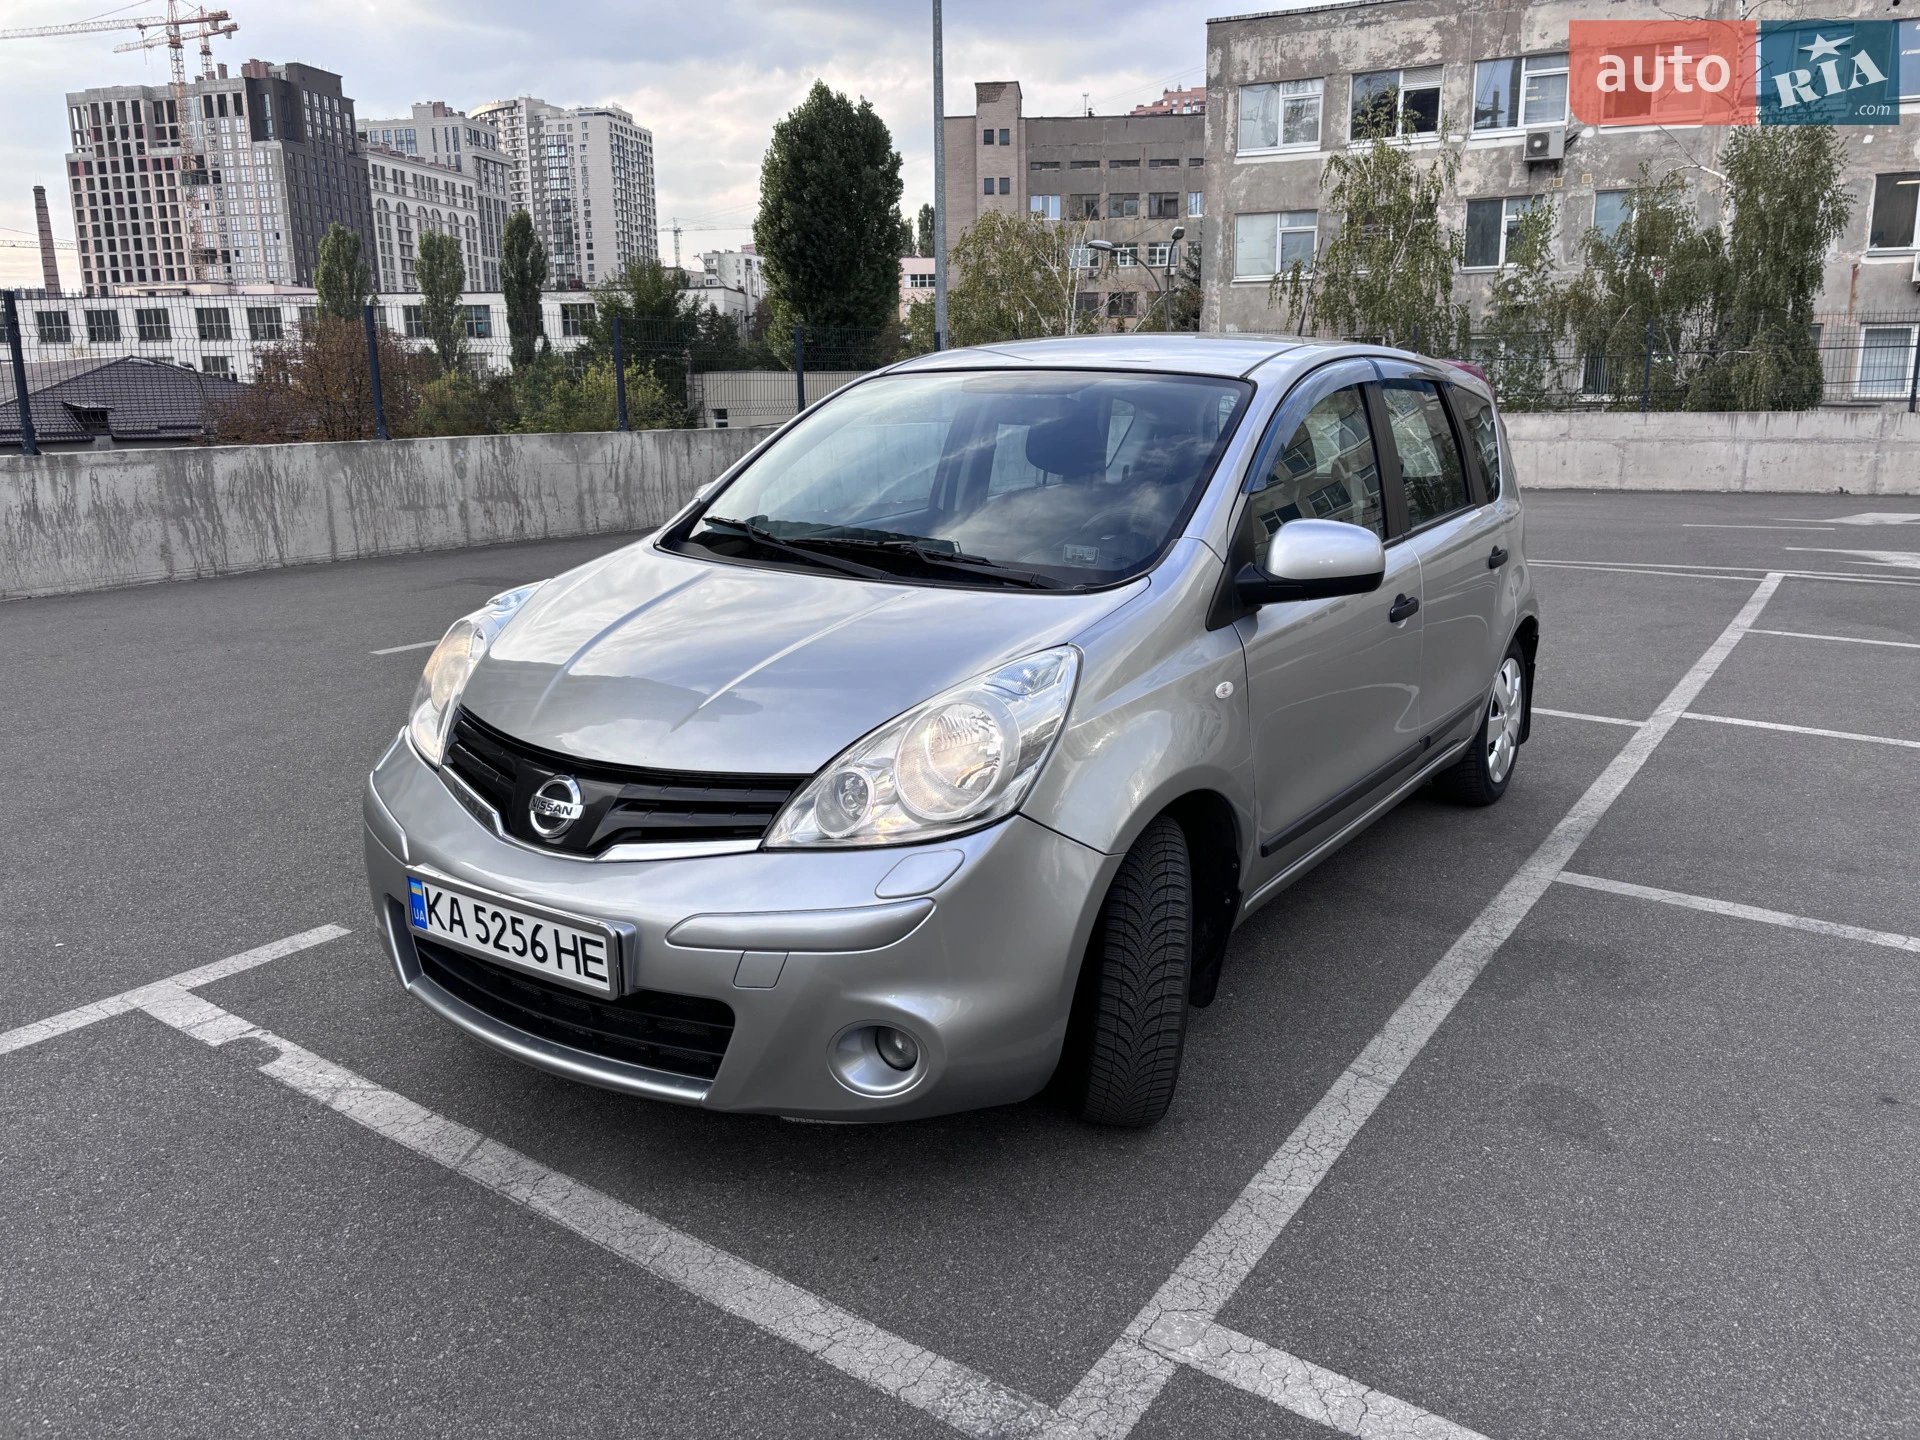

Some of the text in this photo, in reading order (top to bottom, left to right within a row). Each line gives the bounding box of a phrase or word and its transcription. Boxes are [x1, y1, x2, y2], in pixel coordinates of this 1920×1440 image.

[530, 798, 573, 816] NISSAN
[414, 907, 426, 922] UA
[424, 886, 608, 983] KA 5256 HE
